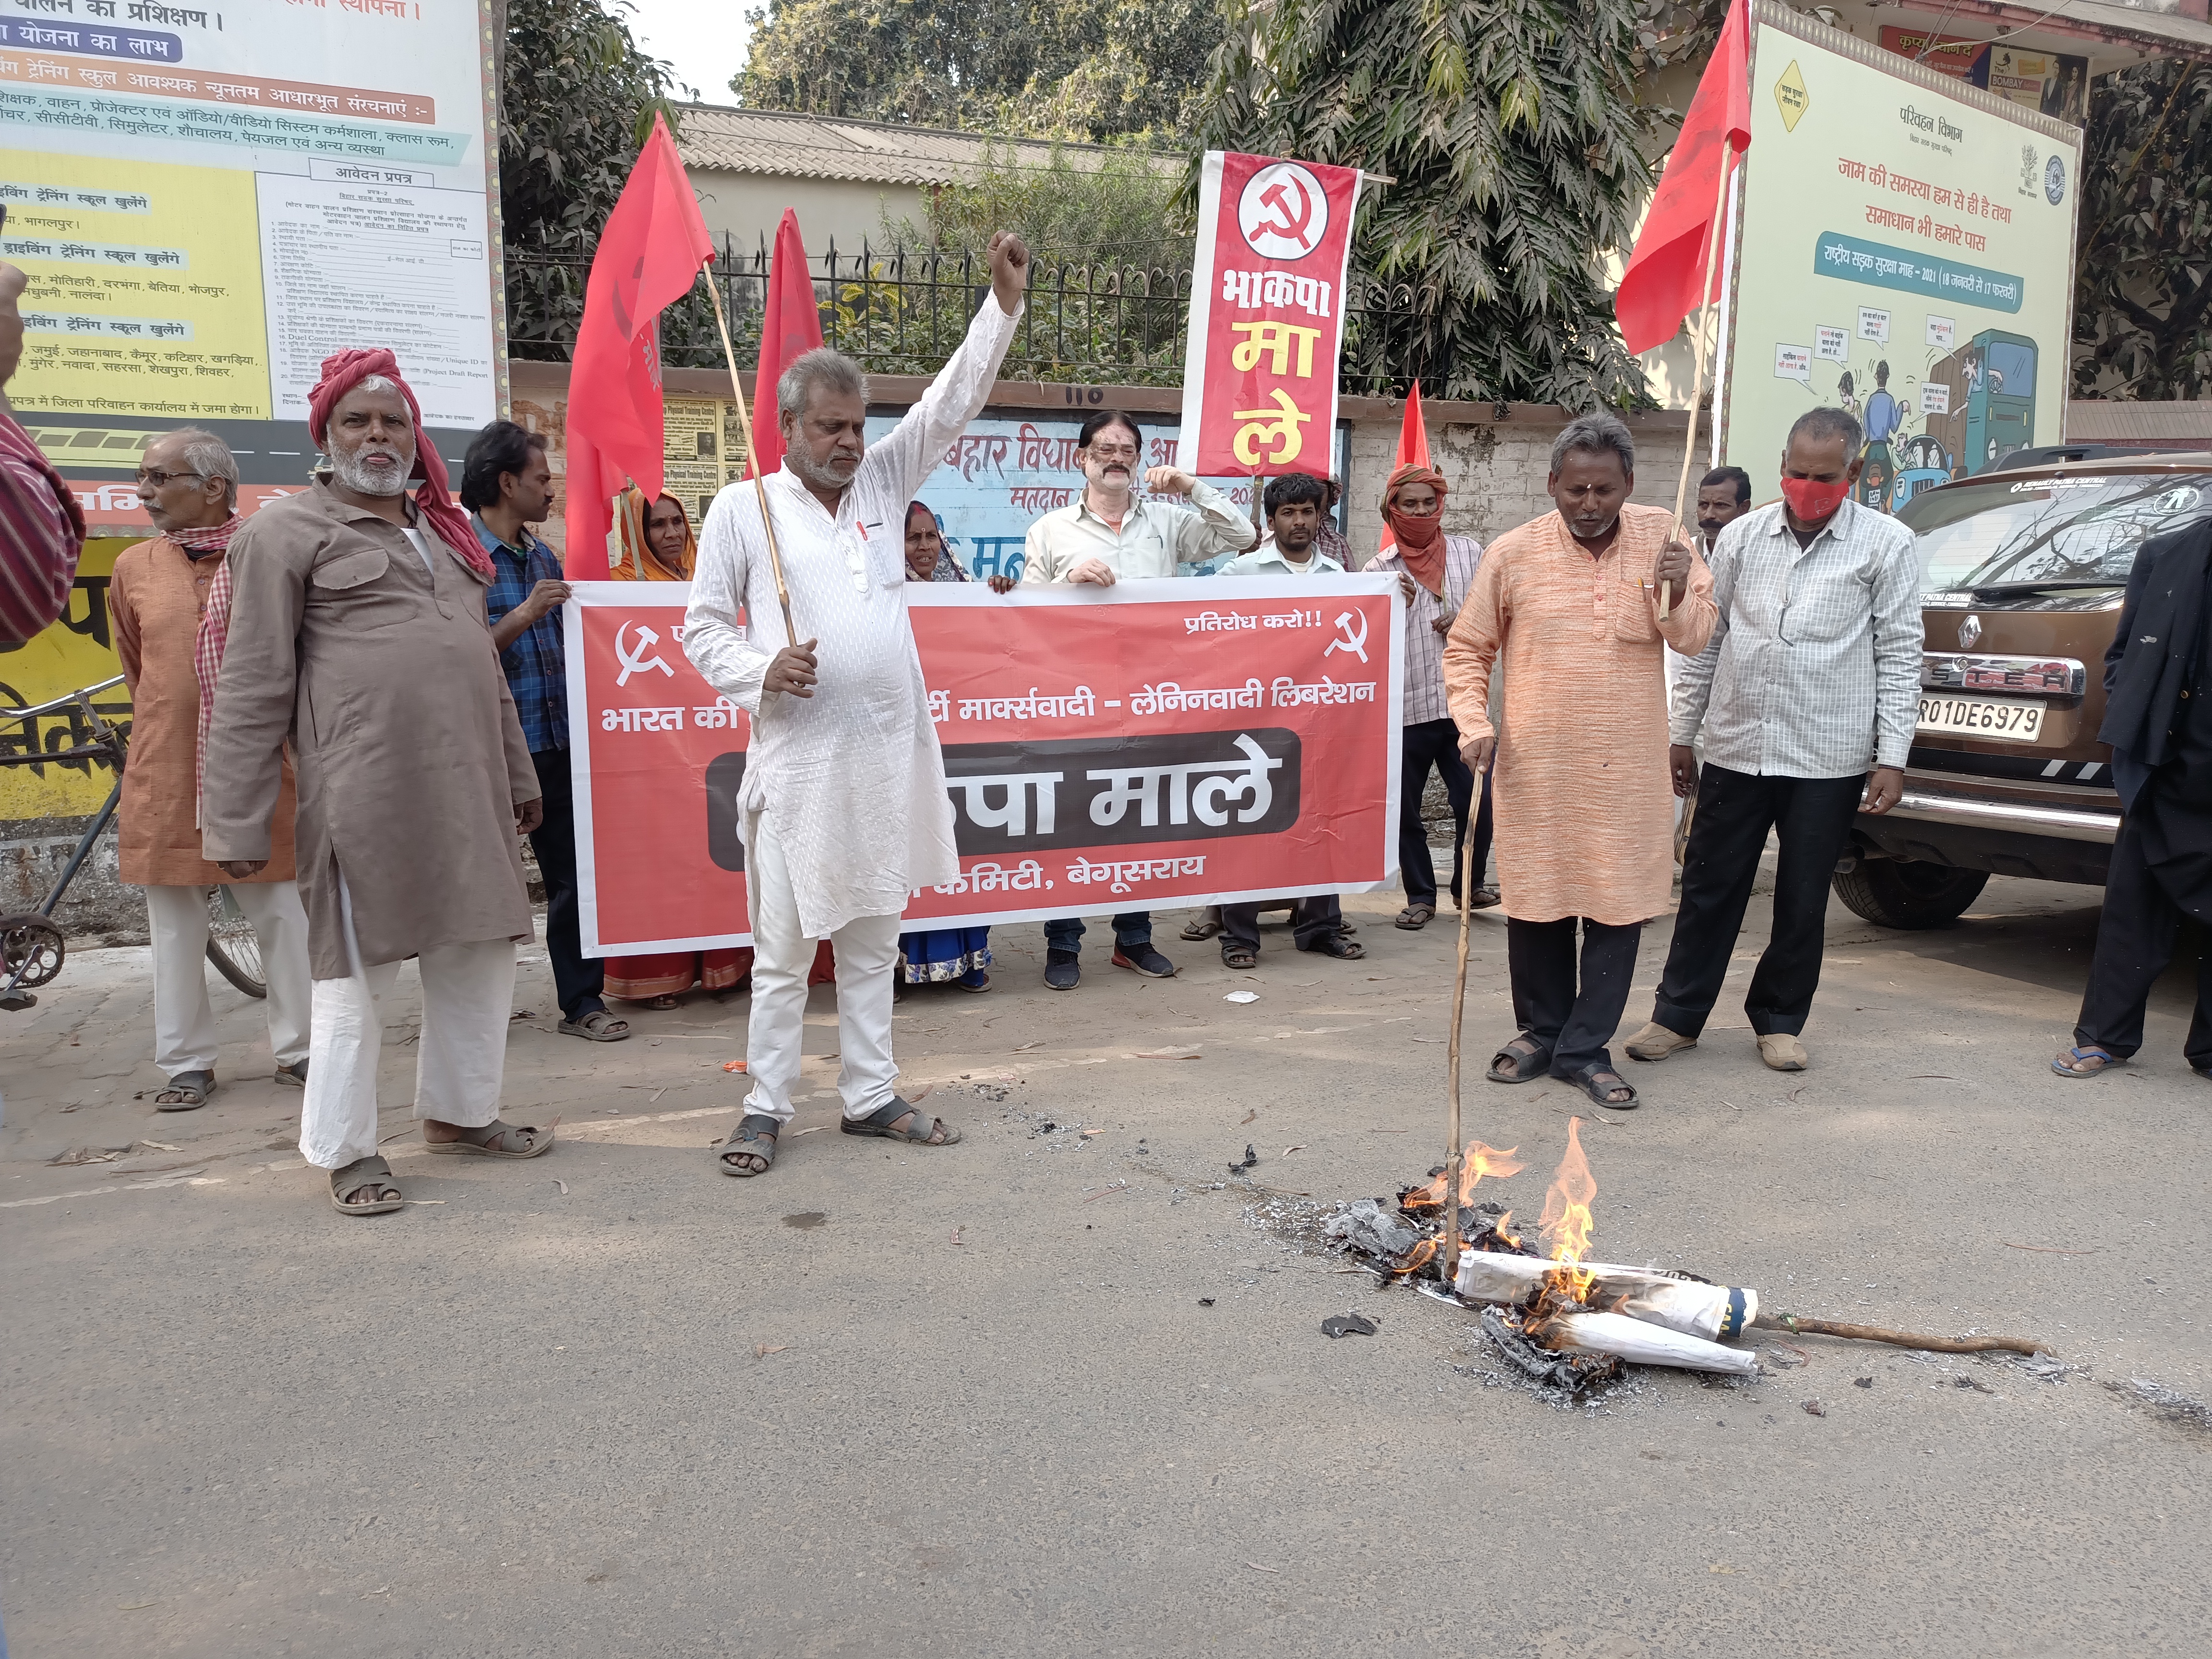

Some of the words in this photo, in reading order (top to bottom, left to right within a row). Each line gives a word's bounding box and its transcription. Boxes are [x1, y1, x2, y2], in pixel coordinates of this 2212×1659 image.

[86, 0, 115, 18] का
[127, 0, 207, 29] प्रशिक्षण
[19, 21, 79, 48] योजना
[90, 33, 117, 51] का
[127, 37, 169, 57] लाभ
[1993, 76, 2023, 89] BOMBAY
[1994, 65, 2005, 73] The
[26, 58, 69, 80] ट्रेनिंग
[127, 72, 197, 92] आवश्यक
[205, 81, 260, 100] न्यूनतम
[268, 88, 338, 112] आधारभूत
[347, 94, 407, 118] संरचनाएं
[34, 109, 104, 129] सीसीटीवी,
[107, 117, 173, 136] सिमुलेटर,
[177, 124, 238, 142] शौचालय,
[241, 130, 287, 145] पेयजल
[291, 136, 310, 148] एवं
[315, 141, 343, 152] अन्य
[348, 144, 385, 156] व्यस्था
[45, 97, 86, 112] वाहन,
[90, 99, 148, 117] प्रोजेक्टर
[150, 106, 171, 119] एवं
[275, 119, 319, 134] सिस्टम
[323, 125, 382, 141] कर्मशाला,
[386, 132, 423, 144] क्लास
[426, 135, 454, 149] रूम,
[1900, 105, 1934, 132] परिवहन
[1938, 116, 1963, 143] विभाग
[335, 167, 380, 181] आवेदन
[384, 173, 412, 185] प्रपत्र
[1839, 157, 1866, 182] जाम
[1869, 164, 1887, 188] की
[1889, 173, 1931, 200] समस्या
[1934, 186, 1951, 206] हम
[1954, 189, 1965, 211] से
[1968, 192, 1979, 215] ही
[1981, 195, 1990, 218] है
[1992, 204, 2011, 224] तथा
[36, 188, 69, 202] ट्रेनिंग
[77, 193, 107, 207] स्कूल
[114, 196, 147, 209] खुलेंगे
[1865, 205, 1915, 233] समाधान
[1918, 215, 1932, 238] भी
[1935, 224, 1963, 246] हमारे
[1965, 231, 1986, 252] पास
[3, 241, 51, 256] ड्राइविंग
[60, 243, 96, 259] ट्रेनिंग
[104, 250, 136, 264] स्कूल
[144, 251, 180, 265] खुलेंगे
[1825, 243, 1851, 266] राष्ट्रीय
[1851, 252, 1874, 272] सड़क
[1875, 256, 1898, 276] सुरक्षा
[1899, 262, 1914, 279] माह
[1922, 267, 1936, 283] 2021
[1951, 274, 1974, 291] जनवरी
[1976, 276, 1983, 293] से
[1984, 283, 1991, 294] 17
[48, 274, 100, 289] मोतिहारी,
[102, 279, 145, 292] दरभंगा,
[147, 281, 185, 294] बेतिया,
[189, 284, 230, 298] भोजपुर,
[1223, 269, 1330, 318] भाकपा
[66, 316, 101, 332] ट्रेनिंग
[109, 322, 141, 336] स्कूल
[150, 324, 185, 337] खुलेंगे
[30, 344, 64, 358] जमुई,
[67, 348, 127, 361] जहानाबाद,
[130, 349, 161, 363] कैमूर,
[164, 350, 208, 364] कटिहार,
[1231, 321, 1321, 378] मा
[62, 360, 99, 372] नवादा,
[103, 362, 146, 375] सहरसा,
[38, 395, 49, 407] में
[50, 395, 83, 408] जिला
[87, 397, 135, 411] परिवाहन
[139, 400, 187, 413] कार्यालय
[191, 402, 200, 414] में
[202, 404, 227, 414] जमा
[668, 406, 684, 415] Physical
[685, 407, 701, 416] Training
[1233, 387, 1311, 465] ले
[671, 470, 686, 480] Physical
[687, 470, 702, 480] Training
[1184, 610, 1256, 635] प्रतिरोध
[1262, 608, 1322, 630] करो!!
[602, 707, 685, 733] भारत
[693, 696, 739, 730] की
[958, 685, 1095, 721] मार्क्सवादी
[1130, 677, 1264, 716] लेनिनवादी
[1270, 675, 1376, 708] लिबरेशन
[1918, 699, 2038, 733] R01DE6979
[1087, 733, 1283, 828] माले
[1066, 855, 1206, 893] बेगूसराय
